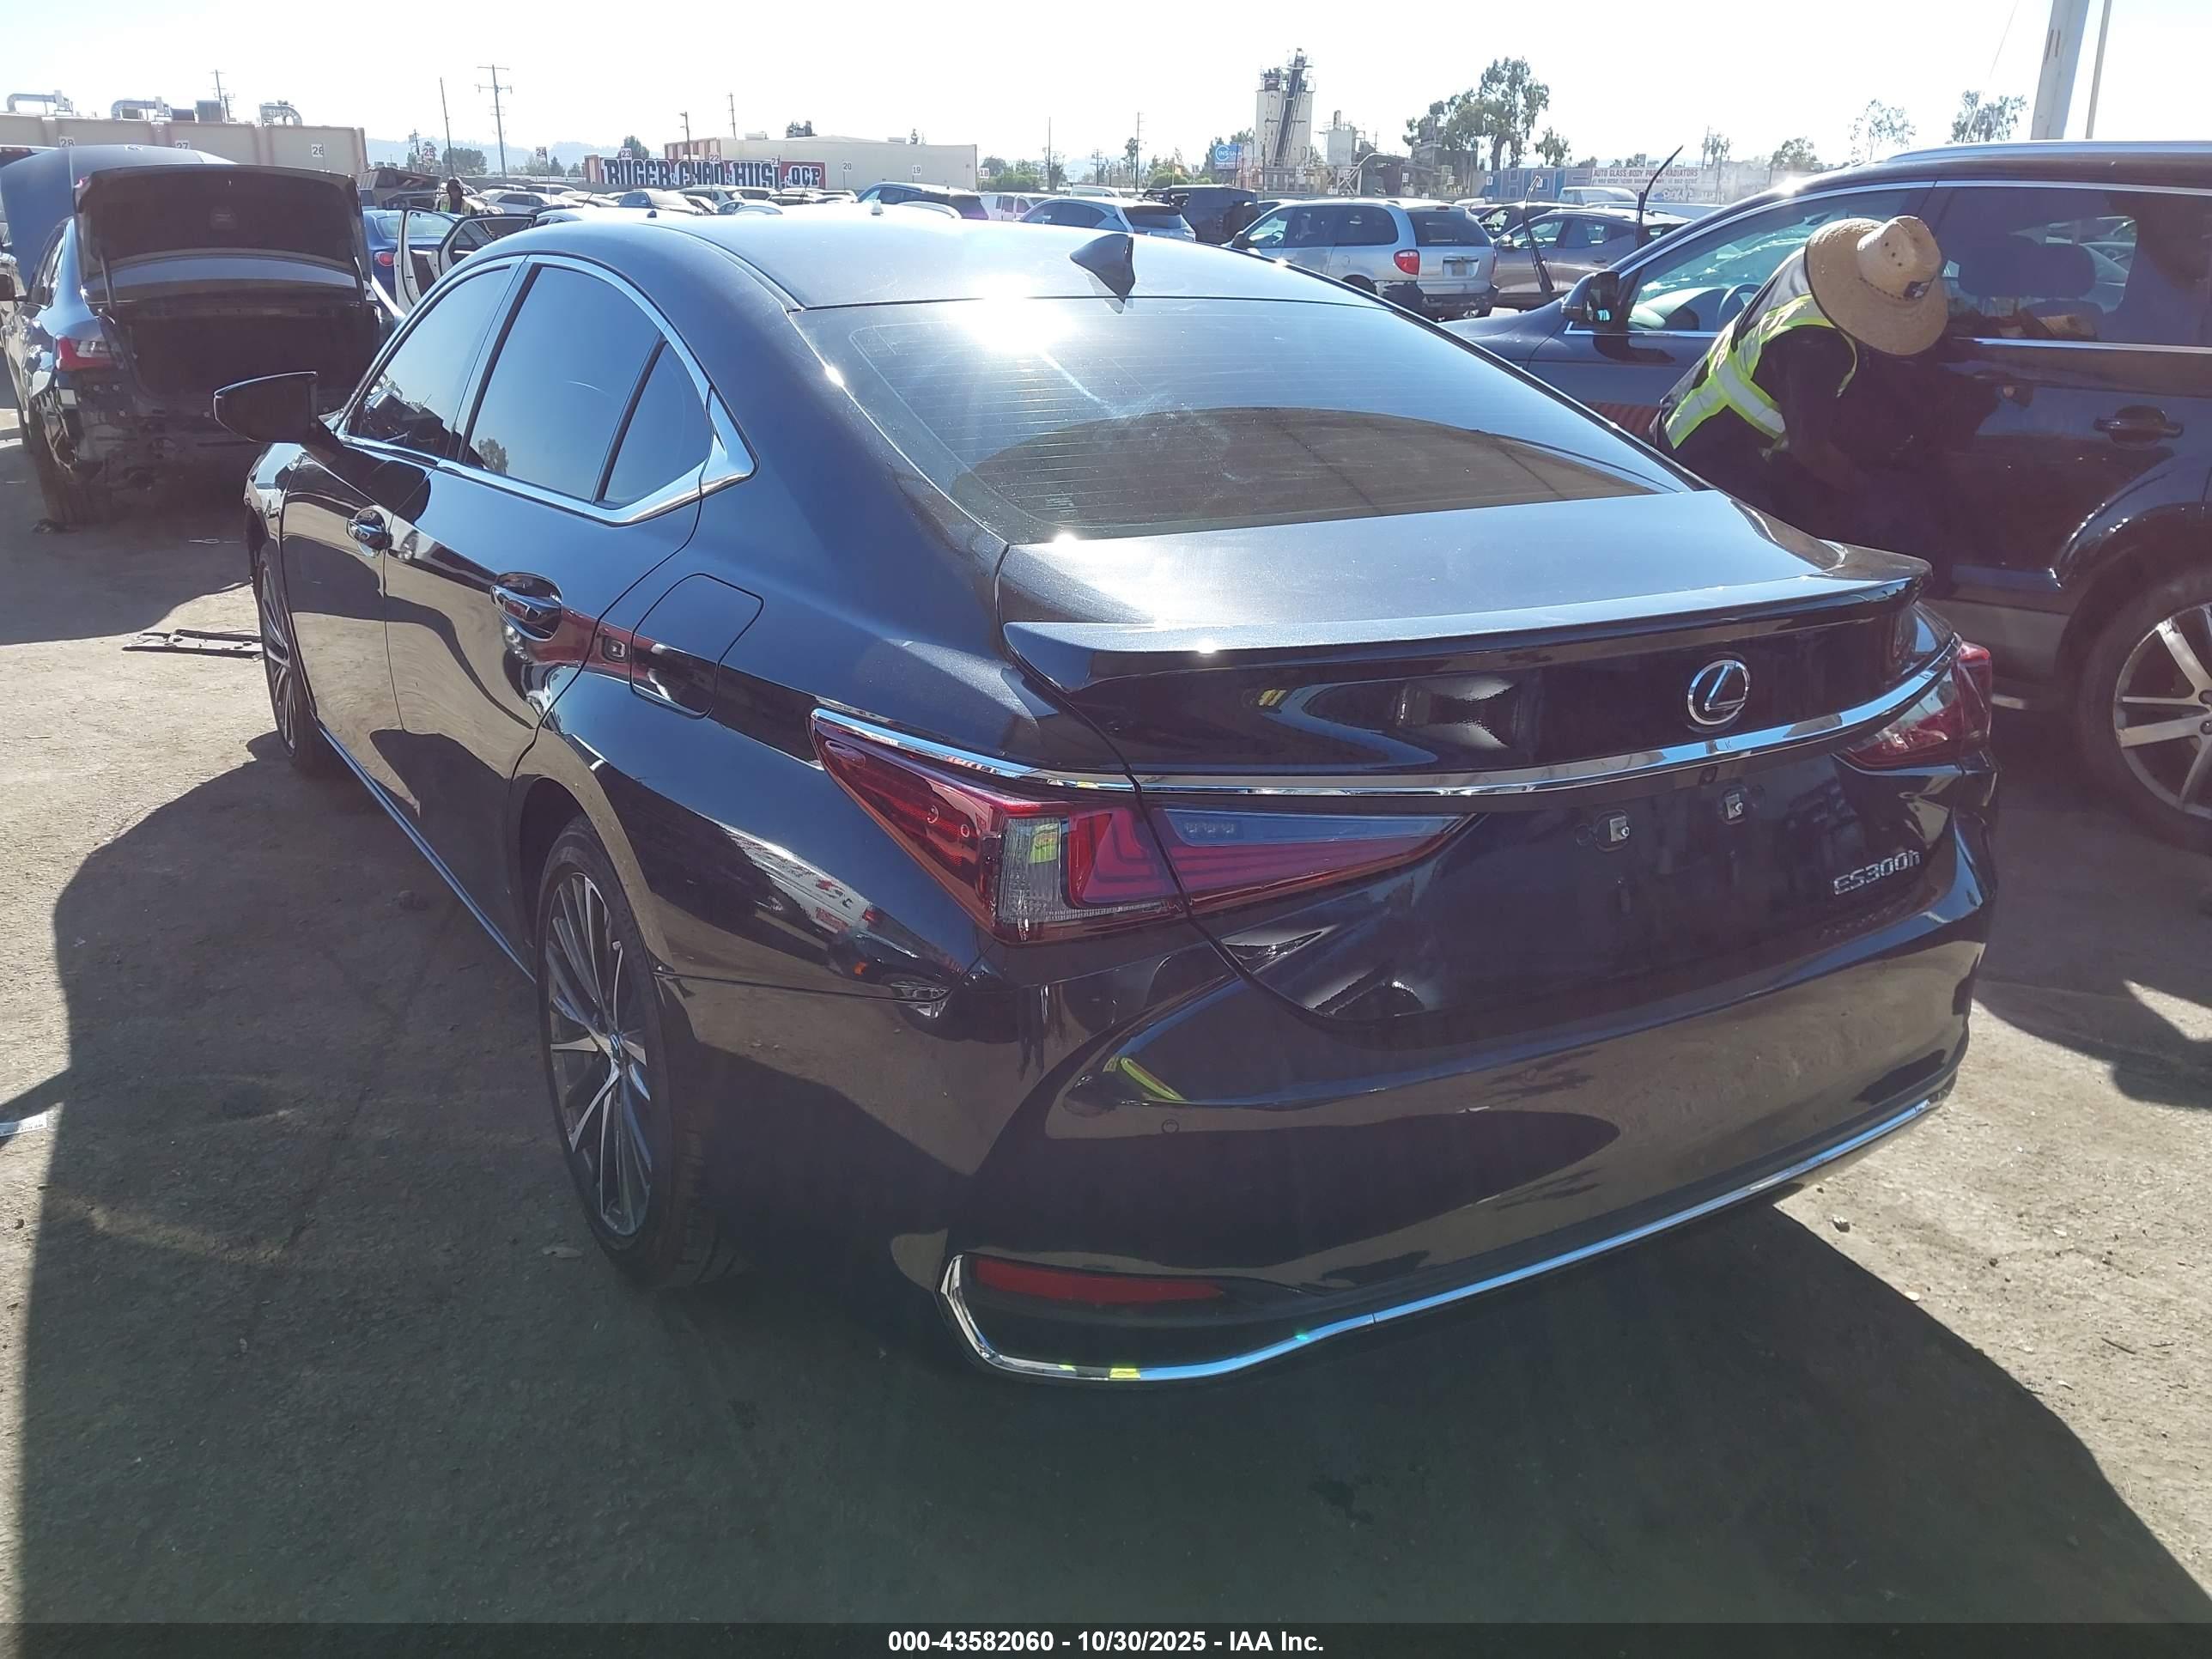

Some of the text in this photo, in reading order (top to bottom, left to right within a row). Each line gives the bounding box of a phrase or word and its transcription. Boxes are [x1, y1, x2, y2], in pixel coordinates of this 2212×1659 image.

[60, 138, 75, 147] 28
[536, 148, 545, 156] 24
[1593, 168, 1608, 177] AUTO
[1833, 848, 1921, 895] ES300h
